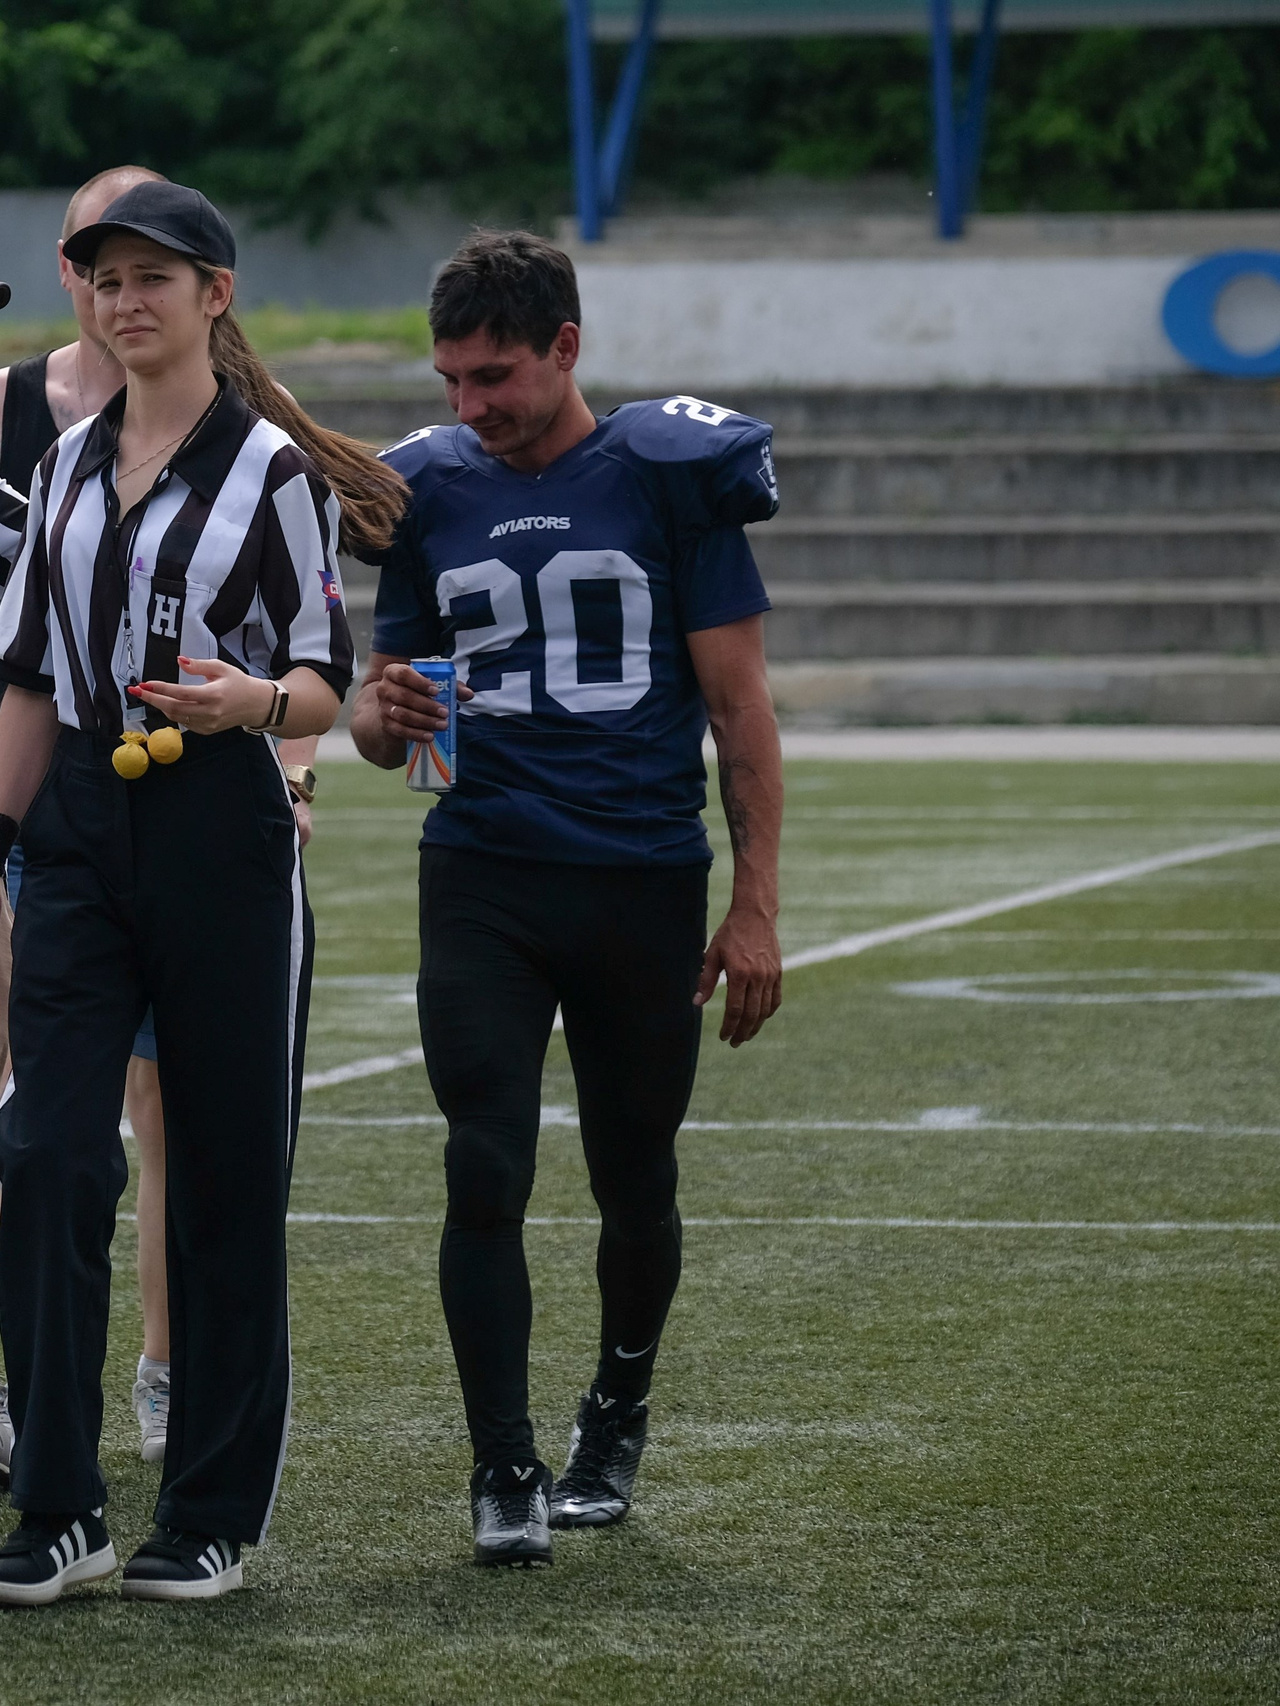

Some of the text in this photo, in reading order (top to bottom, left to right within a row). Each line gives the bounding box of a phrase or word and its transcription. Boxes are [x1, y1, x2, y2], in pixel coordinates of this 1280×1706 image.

[661, 394, 741, 427] 2
[488, 516, 571, 539] AVIATORS
[150, 593, 181, 639] H
[436, 549, 653, 717] 20
